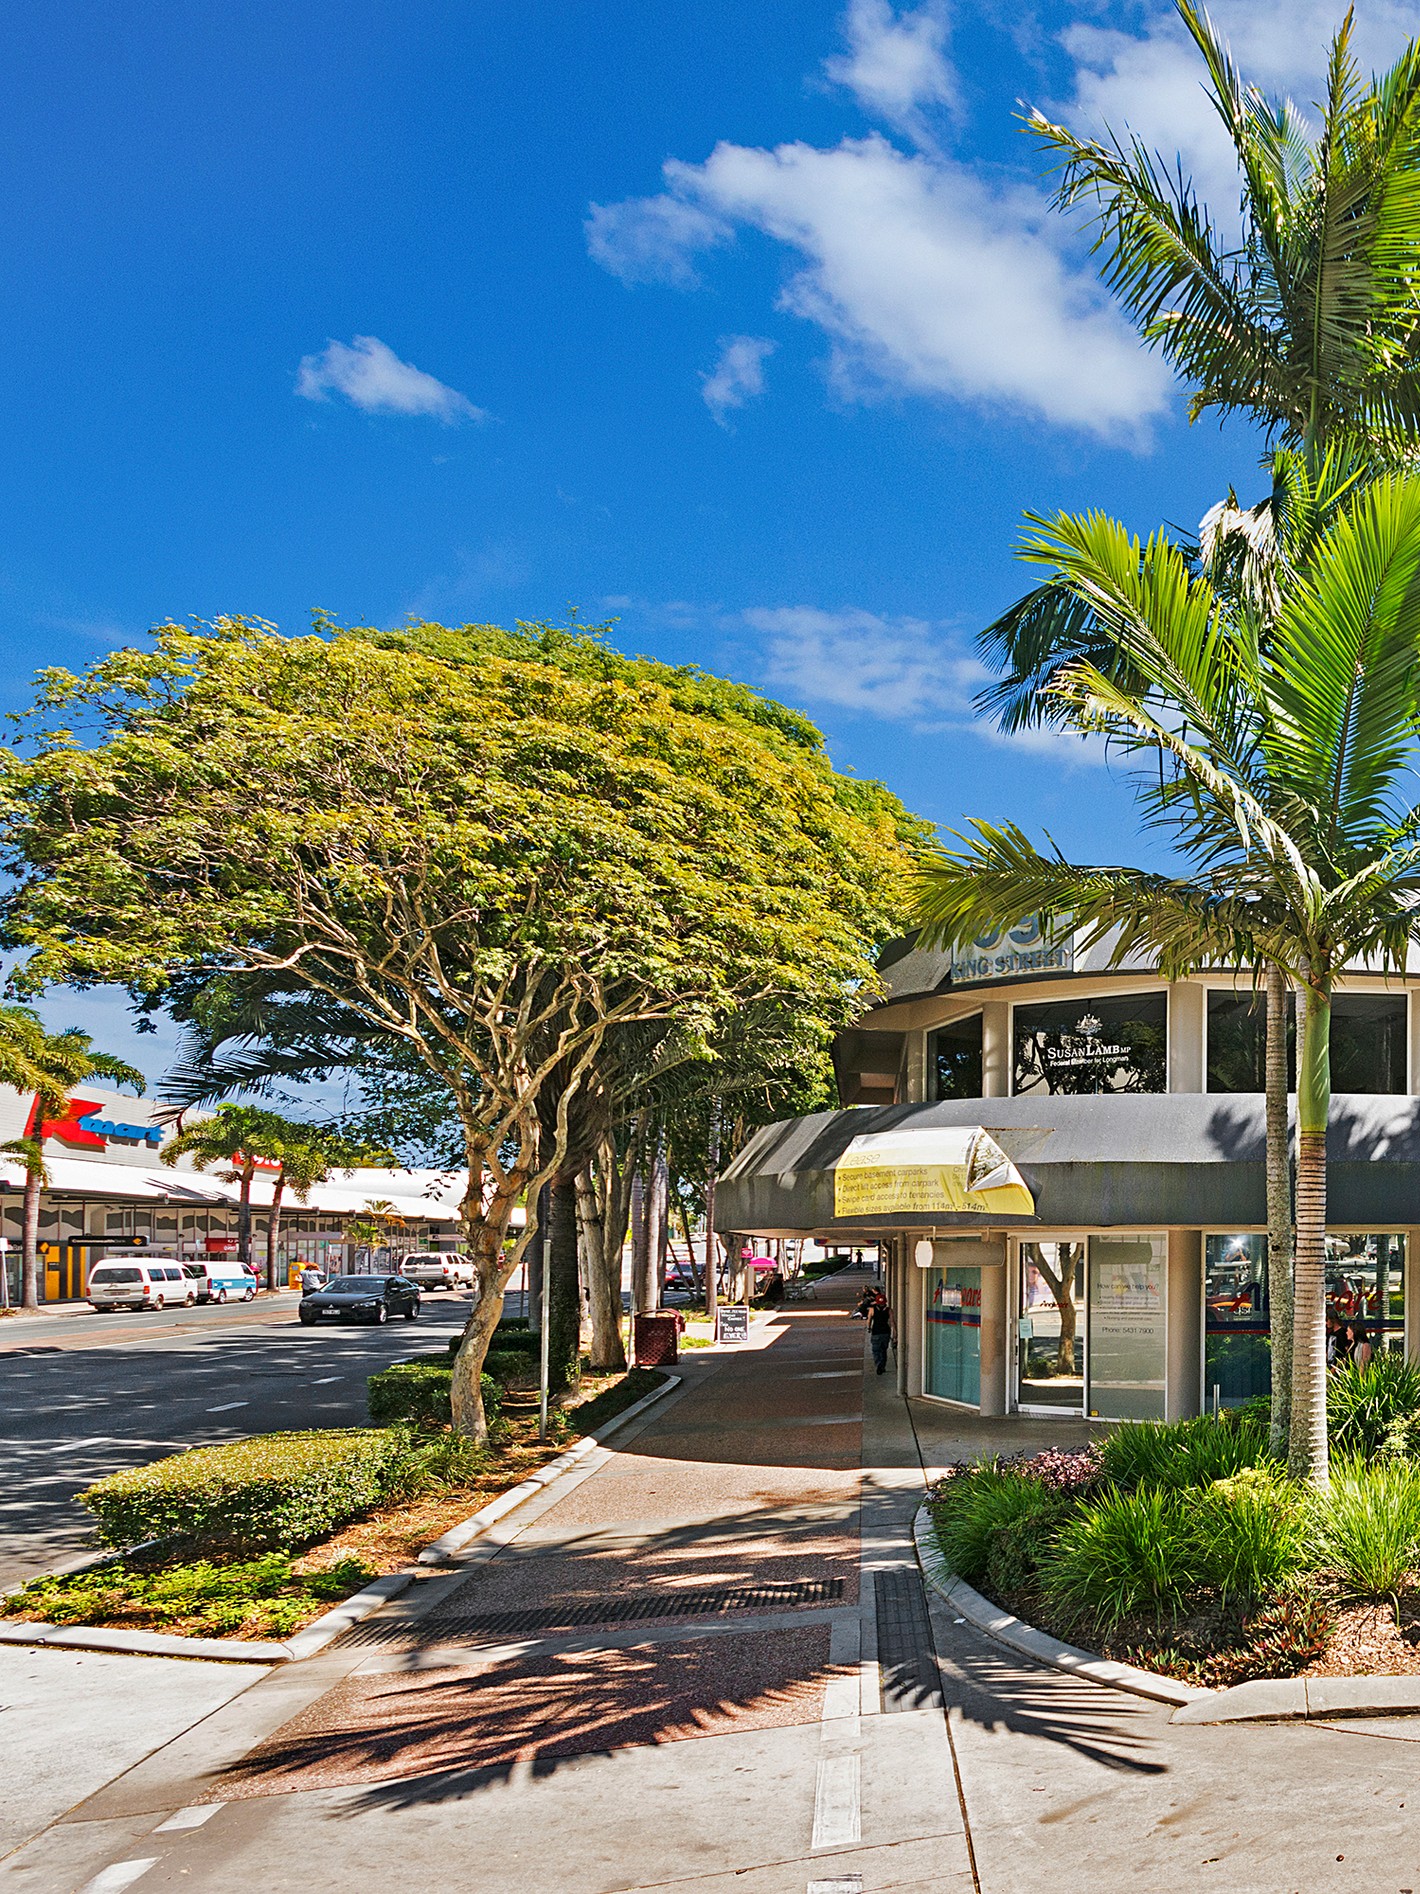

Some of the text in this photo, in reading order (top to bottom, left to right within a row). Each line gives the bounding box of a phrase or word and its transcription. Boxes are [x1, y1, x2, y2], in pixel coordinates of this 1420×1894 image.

[950, 948, 1070, 979] KING STREET
[1102, 1055, 1129, 1064] Longman
[842, 1153, 881, 1167] Lease
[842, 1167, 928, 1181] Secure basement carparks
[842, 1184, 860, 1193] Direct
[870, 1181, 892, 1190] access
[894, 1180, 910, 1188] from
[911, 1179, 939, 1189] carpark
[842, 1195, 860, 1204] Swipe
[862, 1192, 875, 1201] card
[876, 1191, 899, 1200] access
[909, 1190, 945, 1199] tenancies
[842, 1206, 865, 1214] Flexible
[865, 1205, 882, 1213] sizes
[883, 1203, 911, 1212] available
[912, 1202, 930, 1210] from
